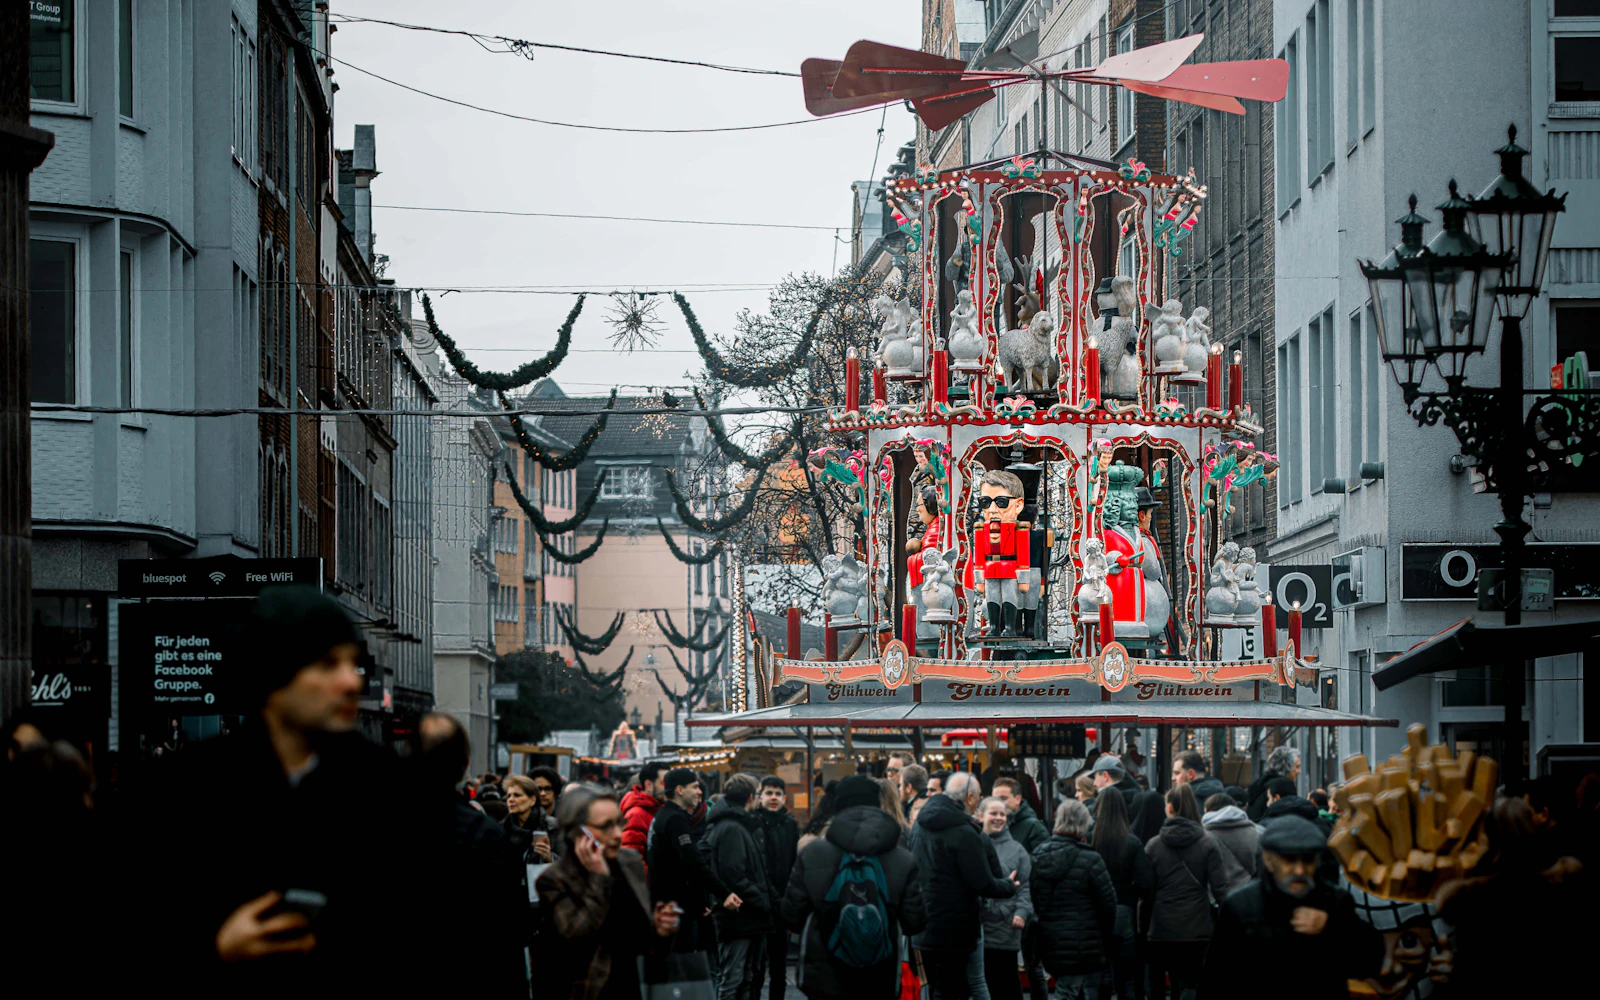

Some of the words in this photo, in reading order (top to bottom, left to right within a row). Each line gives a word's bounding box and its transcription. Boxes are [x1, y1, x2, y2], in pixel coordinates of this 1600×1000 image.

[36, 2, 61, 15] Group
[142, 572, 187, 586] bluespot
[246, 572, 268, 583] Free
[270, 571, 294, 583] WiFi
[154, 635, 175, 647] Für
[174, 635, 210, 650] jeden
[154, 649, 179, 664] gibt
[180, 652, 195, 661] es
[196, 649, 223, 661] eine
[154, 663, 214, 676] Facebook
[153, 678, 203, 693] Gruppe.
[825, 682, 898, 702] Glühwein
[946, 682, 1071, 702] Glühwein
[1134, 682, 1233, 701] Glühwein
